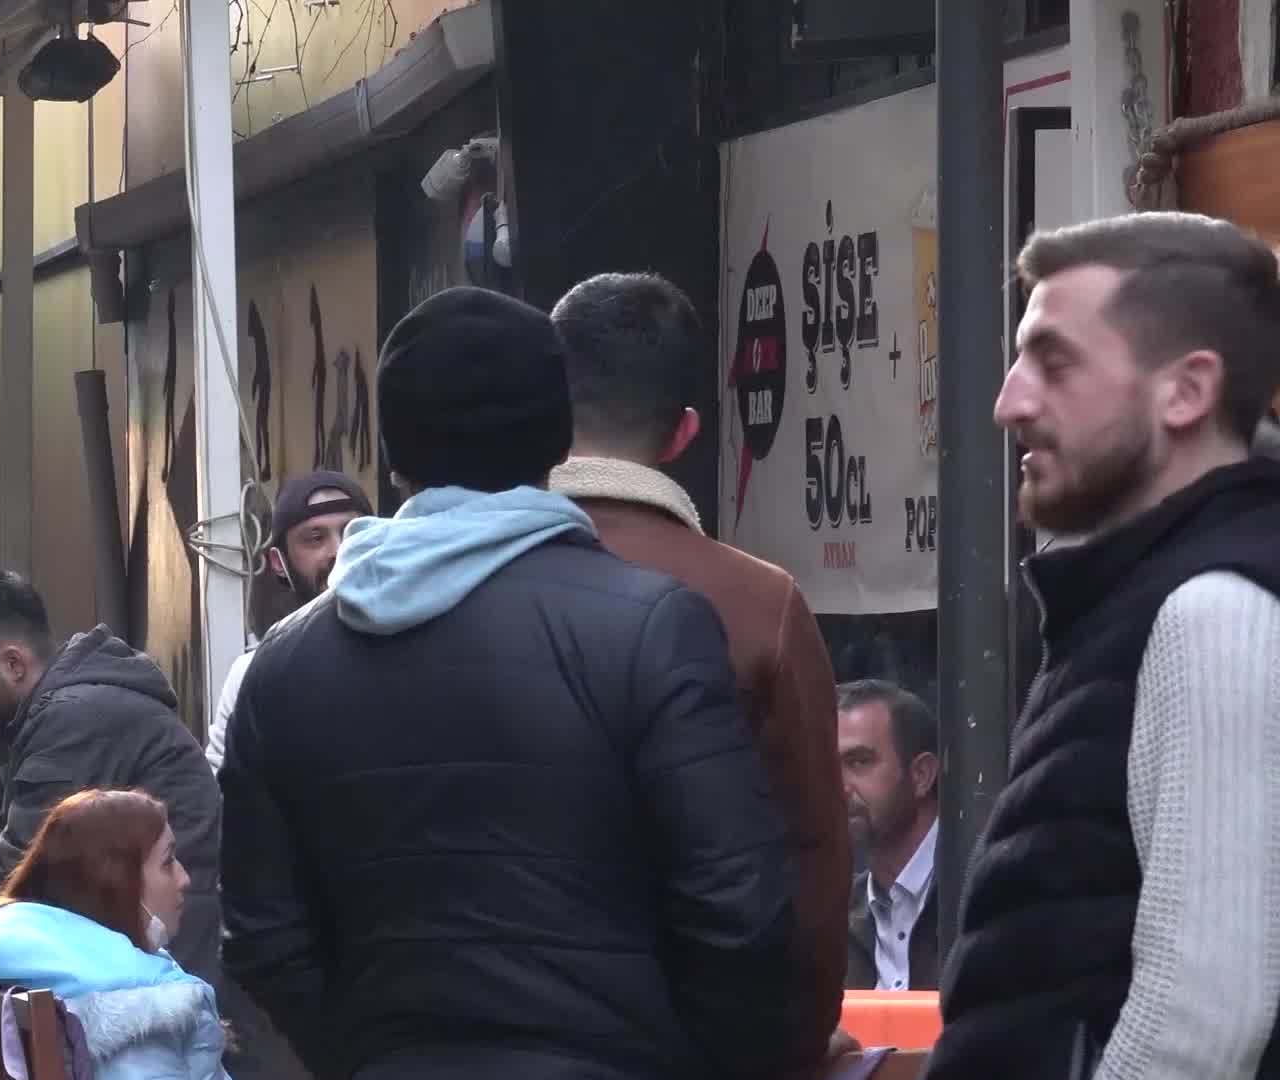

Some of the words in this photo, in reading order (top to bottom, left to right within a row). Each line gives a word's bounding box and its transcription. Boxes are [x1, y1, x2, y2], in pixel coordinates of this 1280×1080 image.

[746, 284, 777, 322] DEEP
[801, 199, 880, 394] ŞİŞE
[748, 389, 773, 425] BAR
